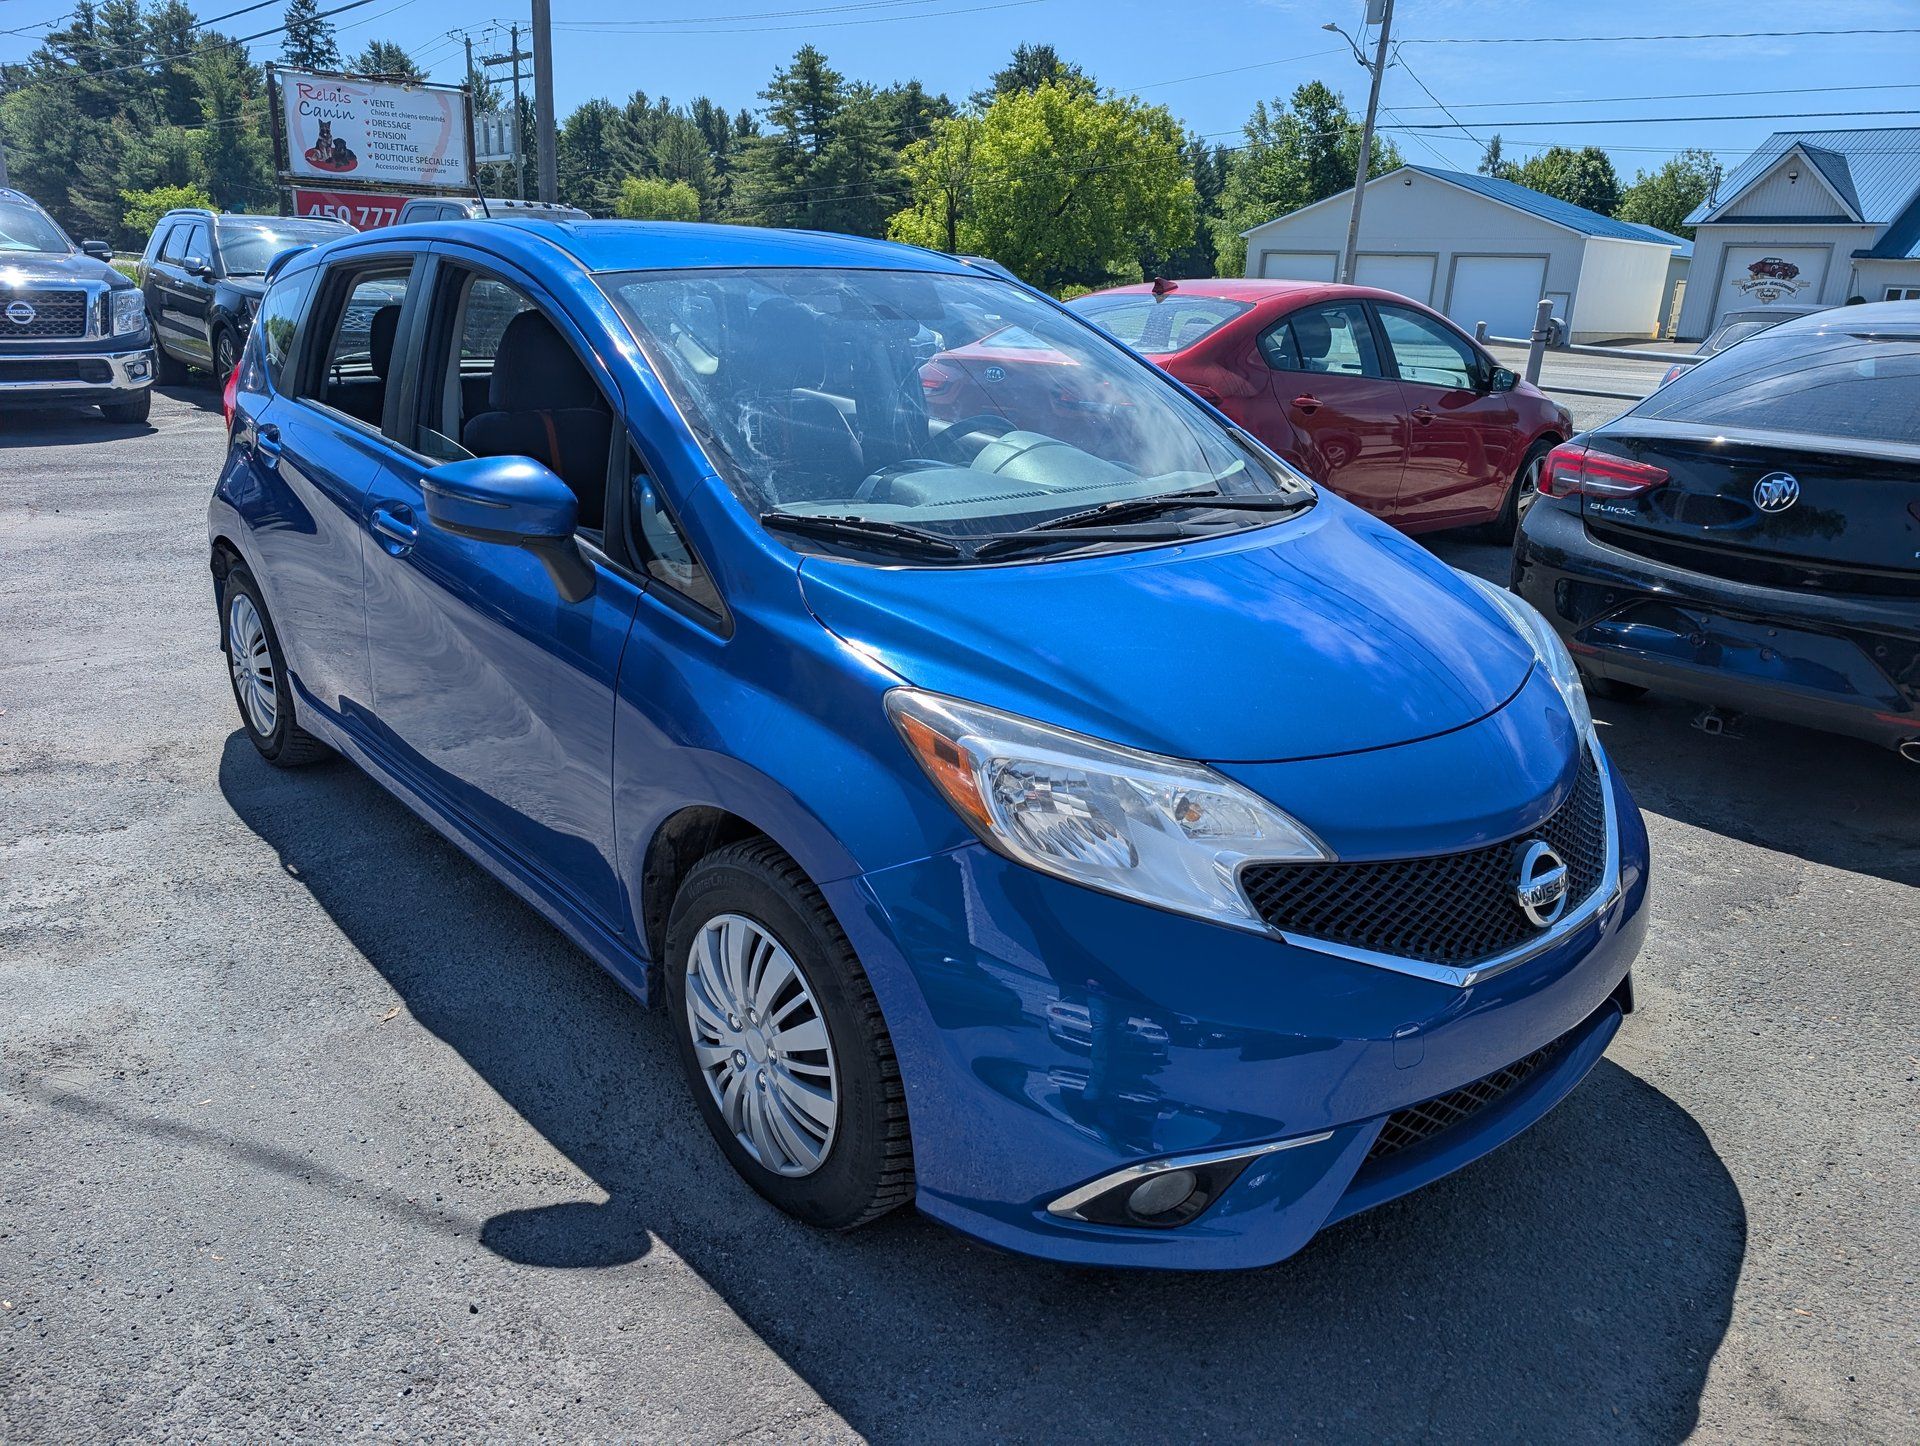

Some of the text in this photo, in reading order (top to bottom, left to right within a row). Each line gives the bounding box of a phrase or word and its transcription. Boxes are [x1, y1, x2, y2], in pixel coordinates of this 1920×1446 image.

[296, 82, 351, 103] Relais
[299, 100, 355, 120] Canin
[369, 99, 395, 109] VENTE
[370, 108, 390, 117] Chiots
[399, 111, 418, 120] chiens
[371, 119, 412, 130] DRESSAGE
[372, 130, 407, 141] PENSION
[373, 141, 419, 153] TOILETTAGE
[374, 153, 459, 167] BOUTIQUE SPÉCIALISÉE
[375, 162, 409, 172] Accessoires
[417, 166, 447, 174] nourriture
[356, 206, 397, 227] 777
[1590, 502, 1636, 517] BUICK
